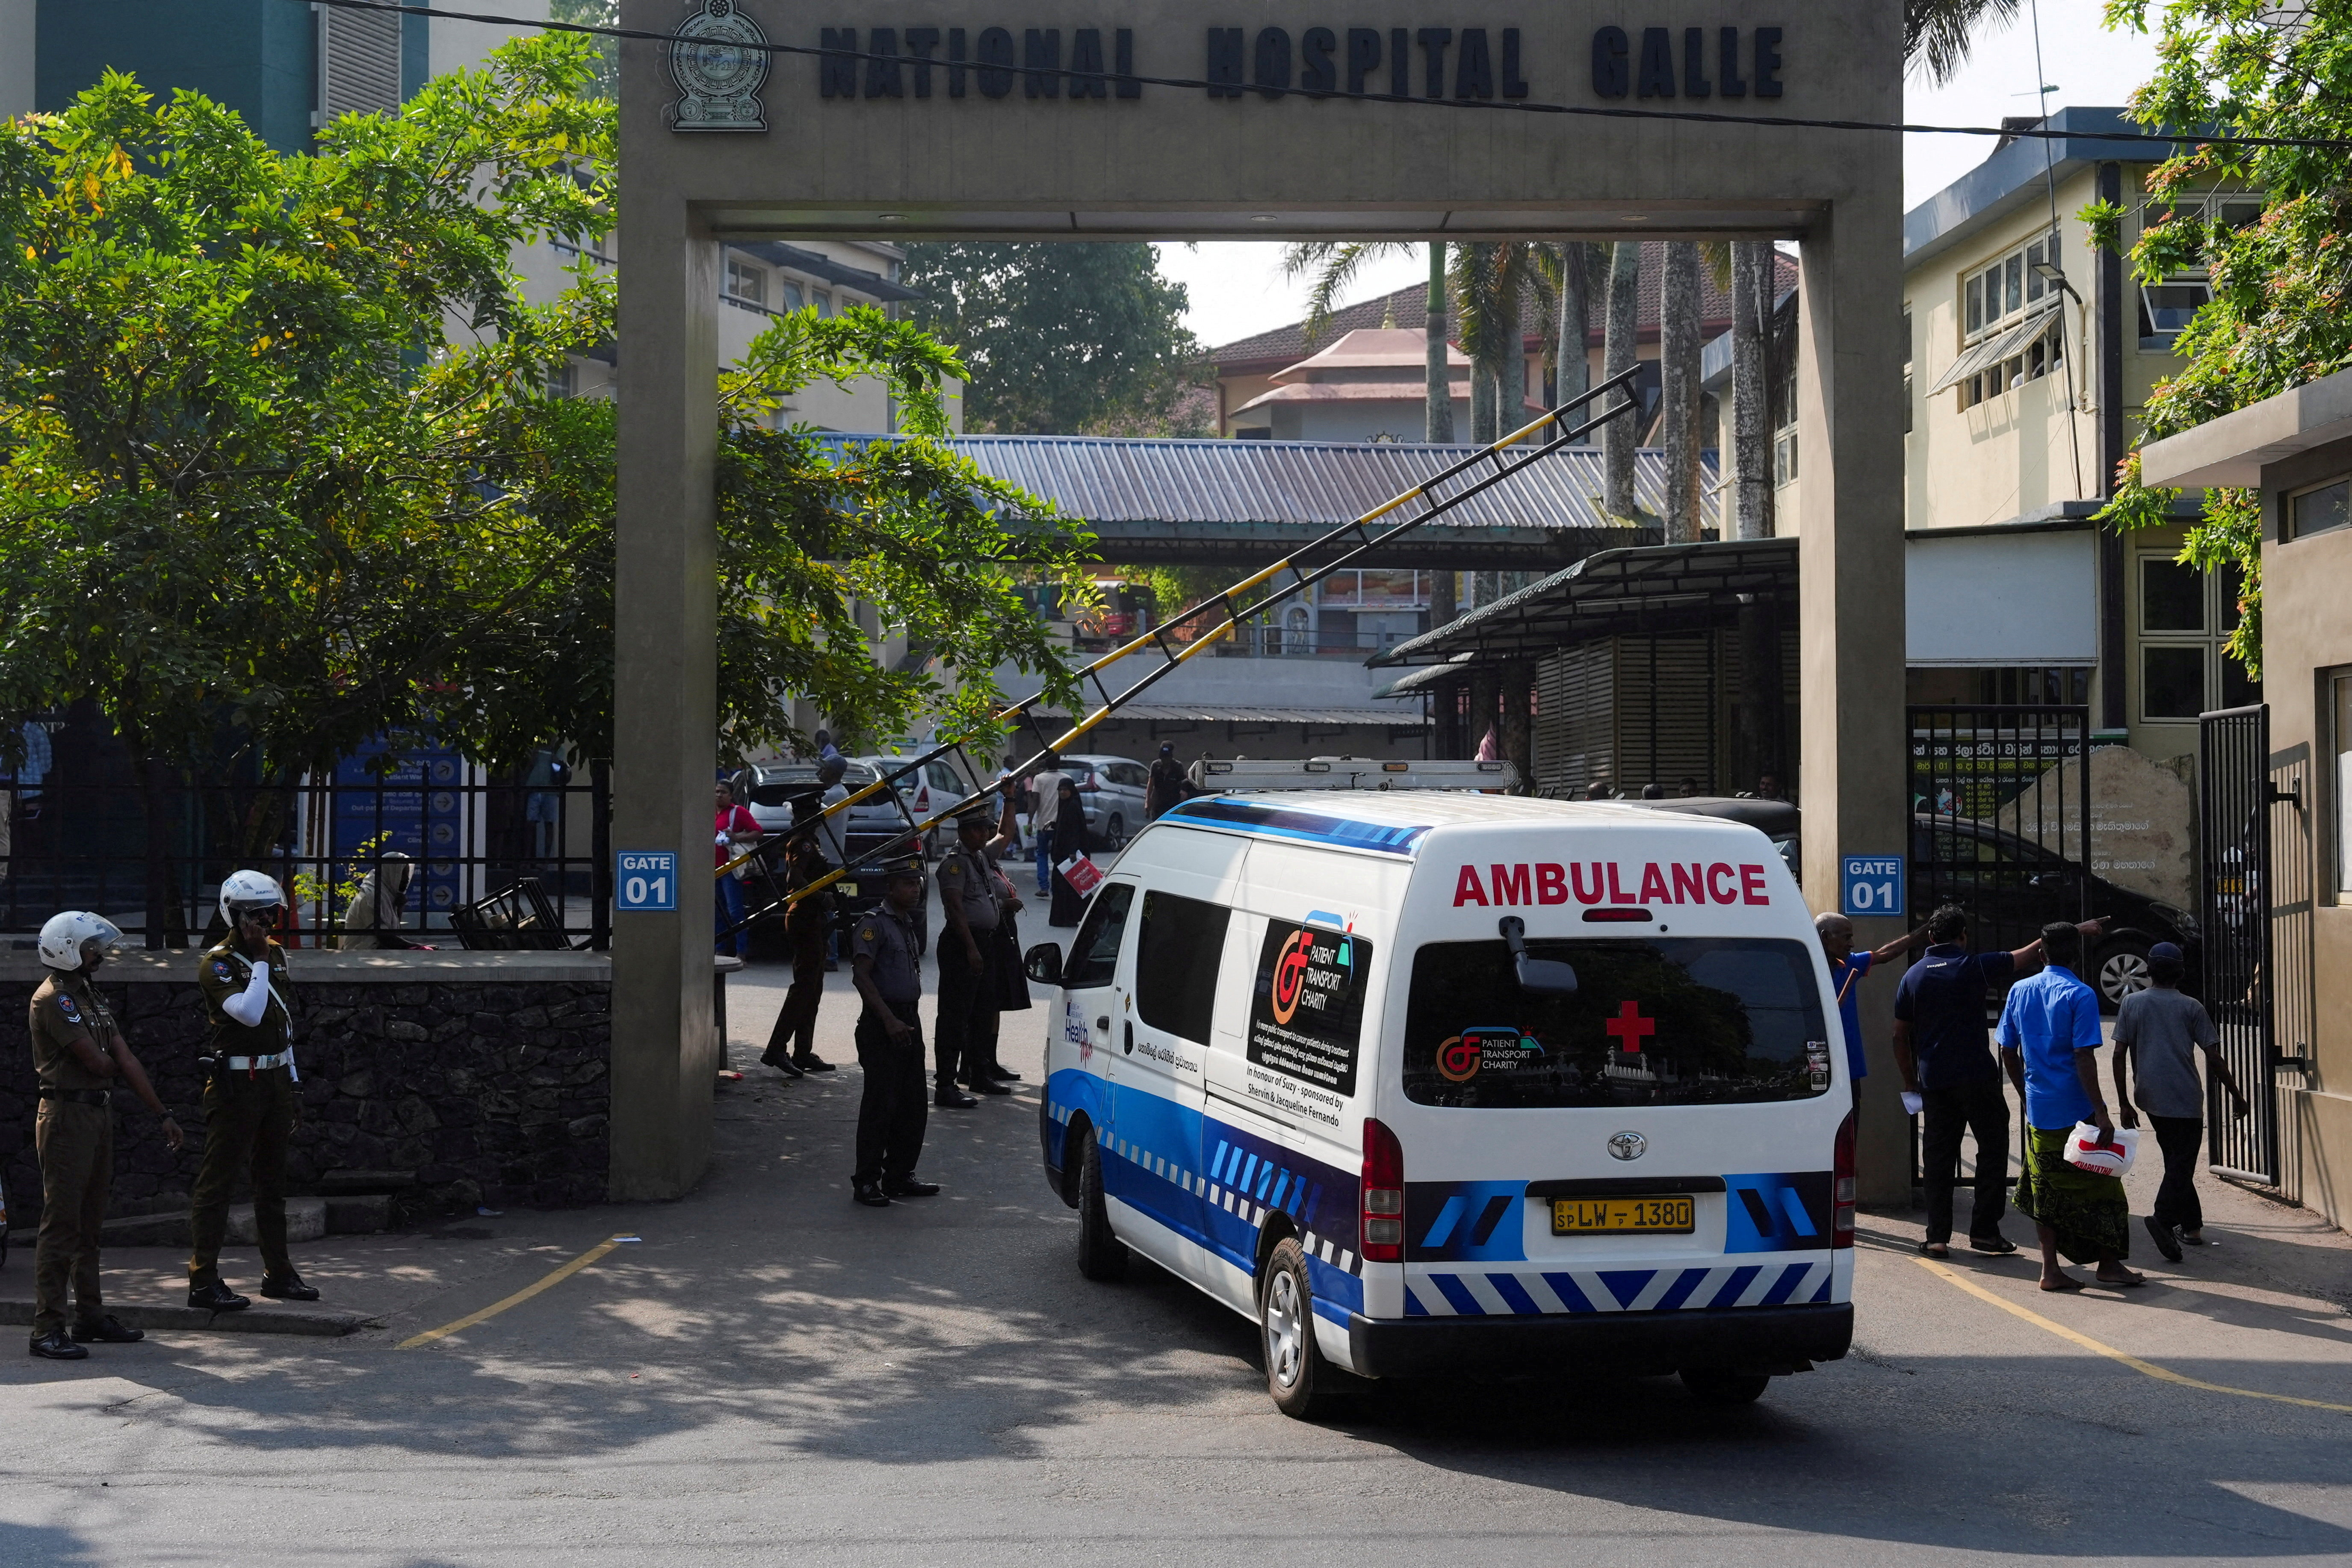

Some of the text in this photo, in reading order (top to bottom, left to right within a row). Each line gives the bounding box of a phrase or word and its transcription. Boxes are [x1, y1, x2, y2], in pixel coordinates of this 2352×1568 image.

[819, 26, 1784, 101] NATIONAL HOSPITAL GALLE
[623, 857, 671, 870] GATE
[1849, 862, 1897, 875] GATE
[626, 877, 667, 904] 01
[1453, 862, 1770, 907] AMBULANCE
[1852, 882, 1893, 909] 01
[1309, 945, 1336, 966] PATIENT
[1306, 967, 1341, 991] TRANSPORT
[1301, 989, 1327, 1011] CHARITY
[1065, 1018, 1088, 1044] Health
[1256, 1019, 1350, 1058] No more public transport to cancer patients during treatment
[1482, 1050, 1531, 1058] TRANSPORT
[1482, 1061, 1518, 1069] CHARITY
[1247, 1065, 1252, 1076] In
[1253, 1067, 1274, 1083] honour
[1275, 1076, 1282, 1086] of
[1282, 1078, 1297, 1094] Suzy
[1301, 1087, 1334, 1105] sponsored
[1335, 1096, 1343, 1112] by
[1248, 1083, 1339, 1127] Shervin & Jacqueline Fernando
[1557, 1215, 1574, 1228] SP
[1578, 1203, 1607, 1226] LW
[1634, 1202, 1689, 1226] 1380
